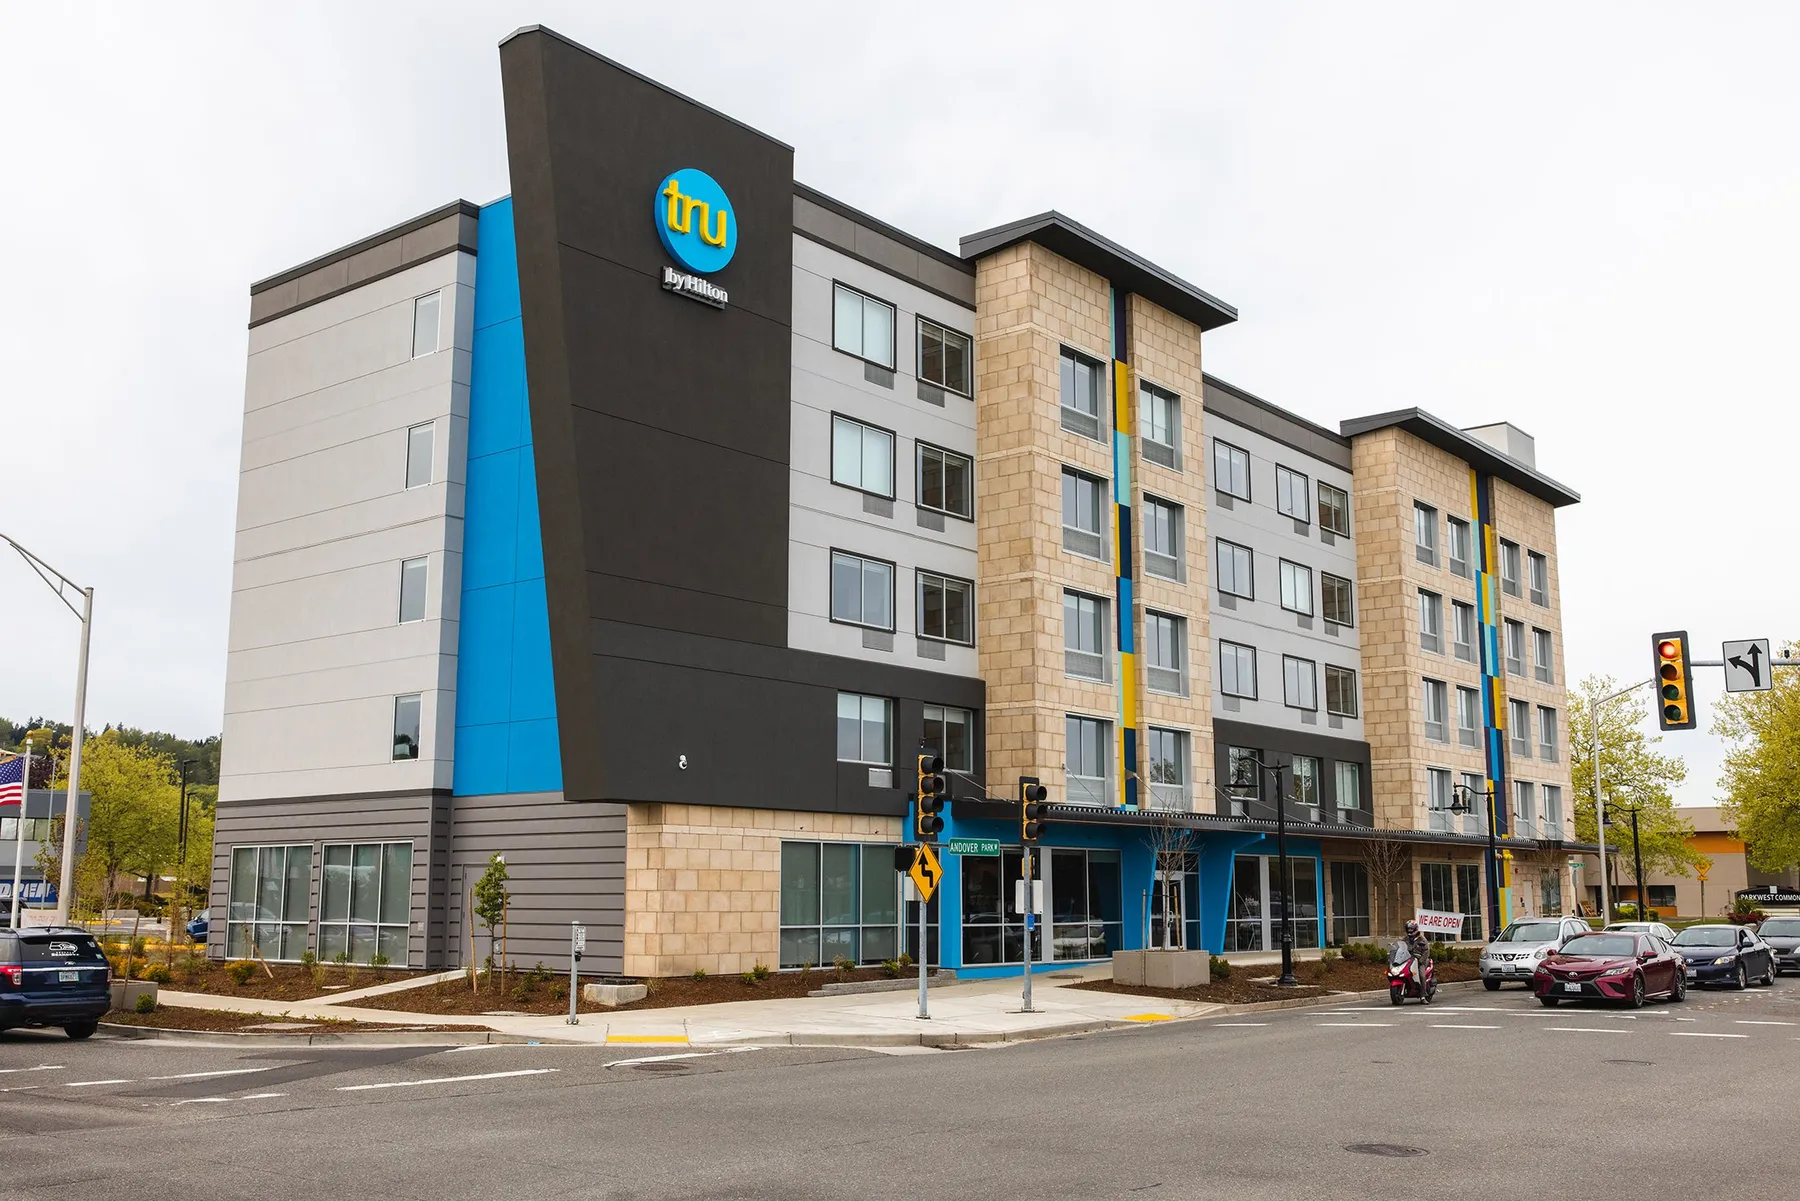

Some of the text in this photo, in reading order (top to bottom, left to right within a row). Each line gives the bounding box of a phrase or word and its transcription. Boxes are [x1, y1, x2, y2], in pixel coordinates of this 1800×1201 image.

[663, 179, 727, 249] tru
[664, 266, 729, 303] by Hilton
[950, 842, 978, 852] ANDOVER
[981, 843, 994, 852] PARK
[1419, 914, 1461, 928] WE ARE OPEN
